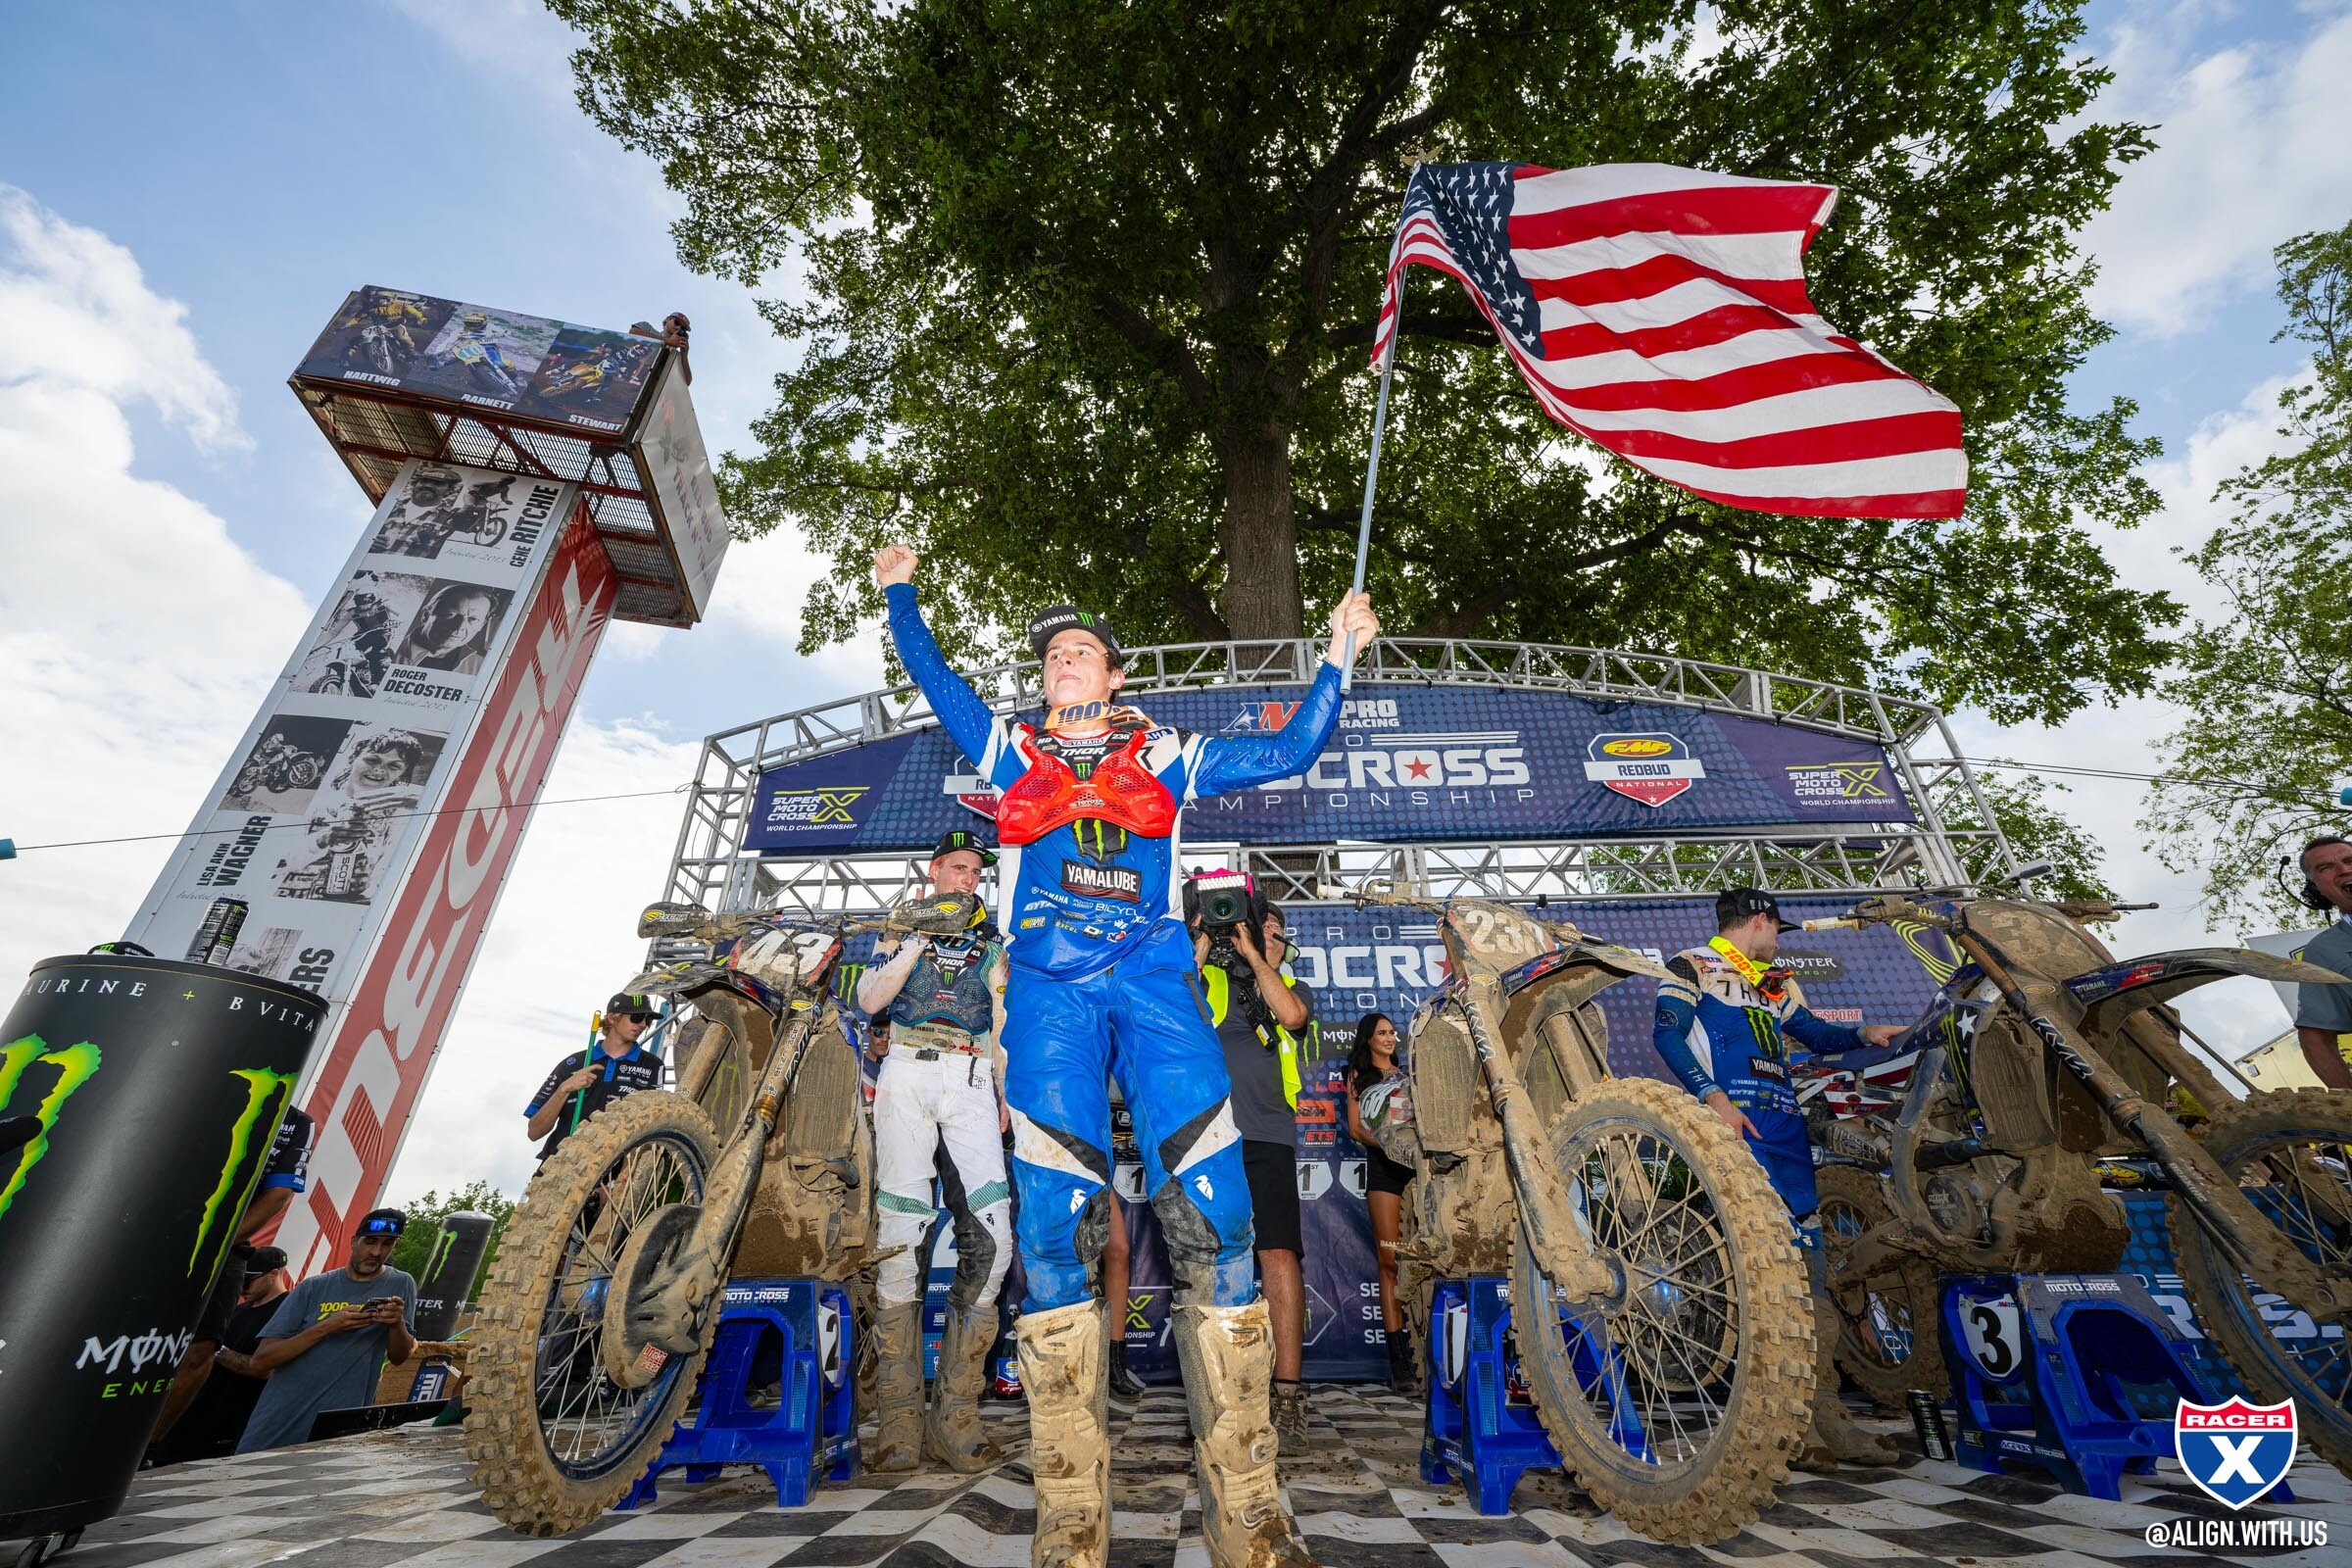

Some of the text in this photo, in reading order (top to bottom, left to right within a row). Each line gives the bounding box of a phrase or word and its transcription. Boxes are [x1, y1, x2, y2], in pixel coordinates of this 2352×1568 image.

[344, 369, 401, 387] HARTWIG
[568, 414, 623, 432] STEWART
[509, 485, 560, 567] GENE RITCHIE
[1040, 613, 1079, 628] YAMAHA
[391, 667, 428, 682] ROGER
[383, 679, 464, 702] DECOSTER
[1055, 699, 1122, 727] 100%
[1339, 699, 1398, 718] PRO
[1339, 717, 1400, 729] RACING
[1059, 747, 1106, 758] THOR
[1603, 740, 1672, 754] FMF
[1256, 748, 1531, 790] CROSS
[1617, 763, 1672, 777] REDBUD
[1788, 771, 1841, 780] SUPER
[1794, 779, 1841, 788] MOTO
[1794, 787, 1845, 796] CROSS
[771, 796, 822, 806] SUPER
[772, 804, 817, 813] MOTO
[767, 811, 817, 821] CROSS
[212, 815, 272, 888] WAGNER
[196, 843, 232, 887] LISA AKIN
[336, 855, 351, 892] SCOTT
[1066, 863, 1138, 893] YAMALUBE
[1039, 889, 1069, 906] YAMAHA
[737, 929, 835, 975] 43
[936, 956, 966, 967] THOR
[1723, 948, 1758, 982] 100%
[1772, 956, 1838, 969] ONSTER
[1305, 1131, 1335, 1142] ETS
[2045, 1282, 2121, 1293] MOTOCROSS
[1970, 1305, 2013, 1374] 3
